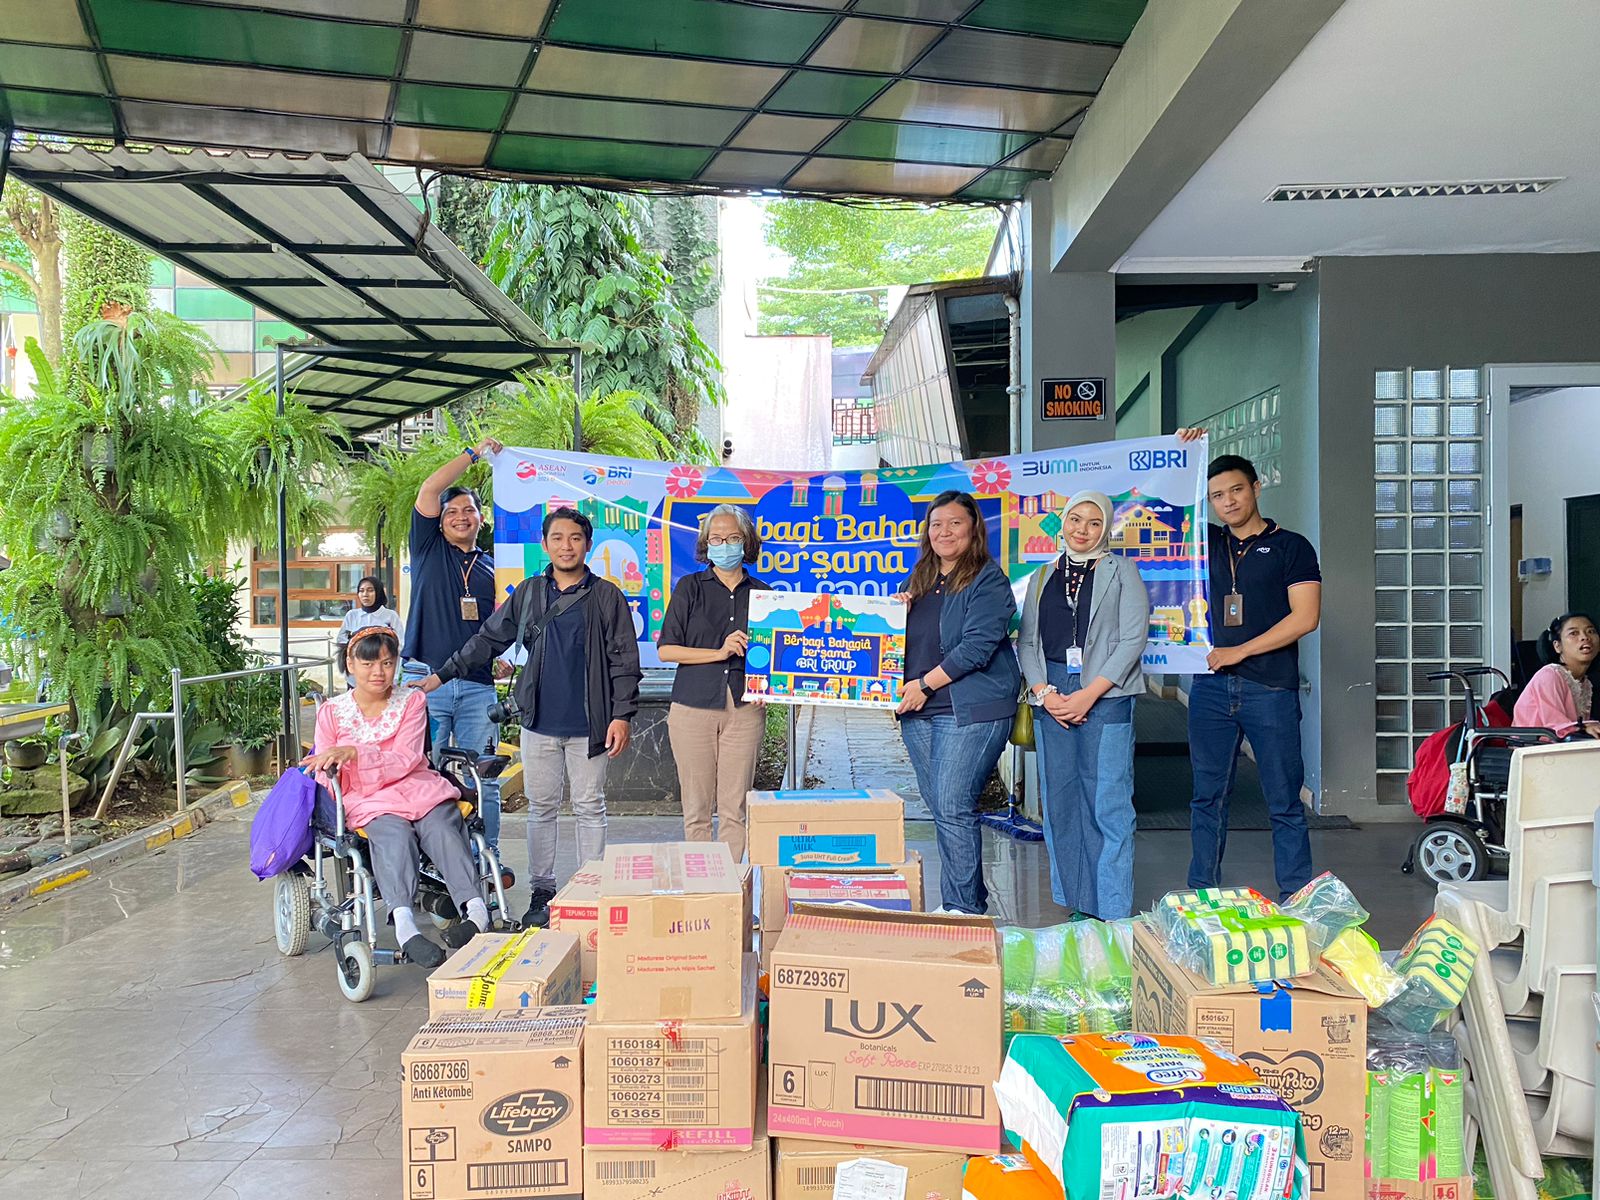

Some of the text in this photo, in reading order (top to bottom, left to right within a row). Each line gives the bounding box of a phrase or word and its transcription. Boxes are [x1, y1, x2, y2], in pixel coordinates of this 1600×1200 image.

[1055, 384, 1071, 399] NO
[1046, 401, 1101, 416] SMOKING
[1152, 450, 1187, 469] BRI
[538, 464, 567, 472] ASEAN
[608, 466, 632, 479] BRI
[796, 657, 856, 673] BRI GROUP
[1140, 654, 1168, 665] NM
[793, 843, 813, 851] MILK
[565, 909, 586, 917] TEPUNG
[777, 968, 846, 989] 68729367
[824, 998, 936, 1042] LUX
[611, 1040, 661, 1049] 1160184
[860, 1043, 897, 1053] Botanicals
[611, 1057, 661, 1066] 1060187
[845, 1051, 917, 1069] Soft Rose
[413, 1062, 467, 1081] 68687366
[1155, 1070, 1197, 1080] Lifree
[611, 1075, 661, 1084] 1060273
[783, 1070, 795, 1094] 6
[413, 1086, 472, 1099] Anti Ketombe
[611, 1092, 661, 1101] 1060274
[490, 1104, 563, 1119] Lifebuoy
[611, 1109, 661, 1118] 61365
[814, 1117, 845, 1130] (Pouch)
[678, 1130, 736, 1139] REFILL
[507, 1138, 552, 1153] SAMPO
[417, 1168, 427, 1188] 6
